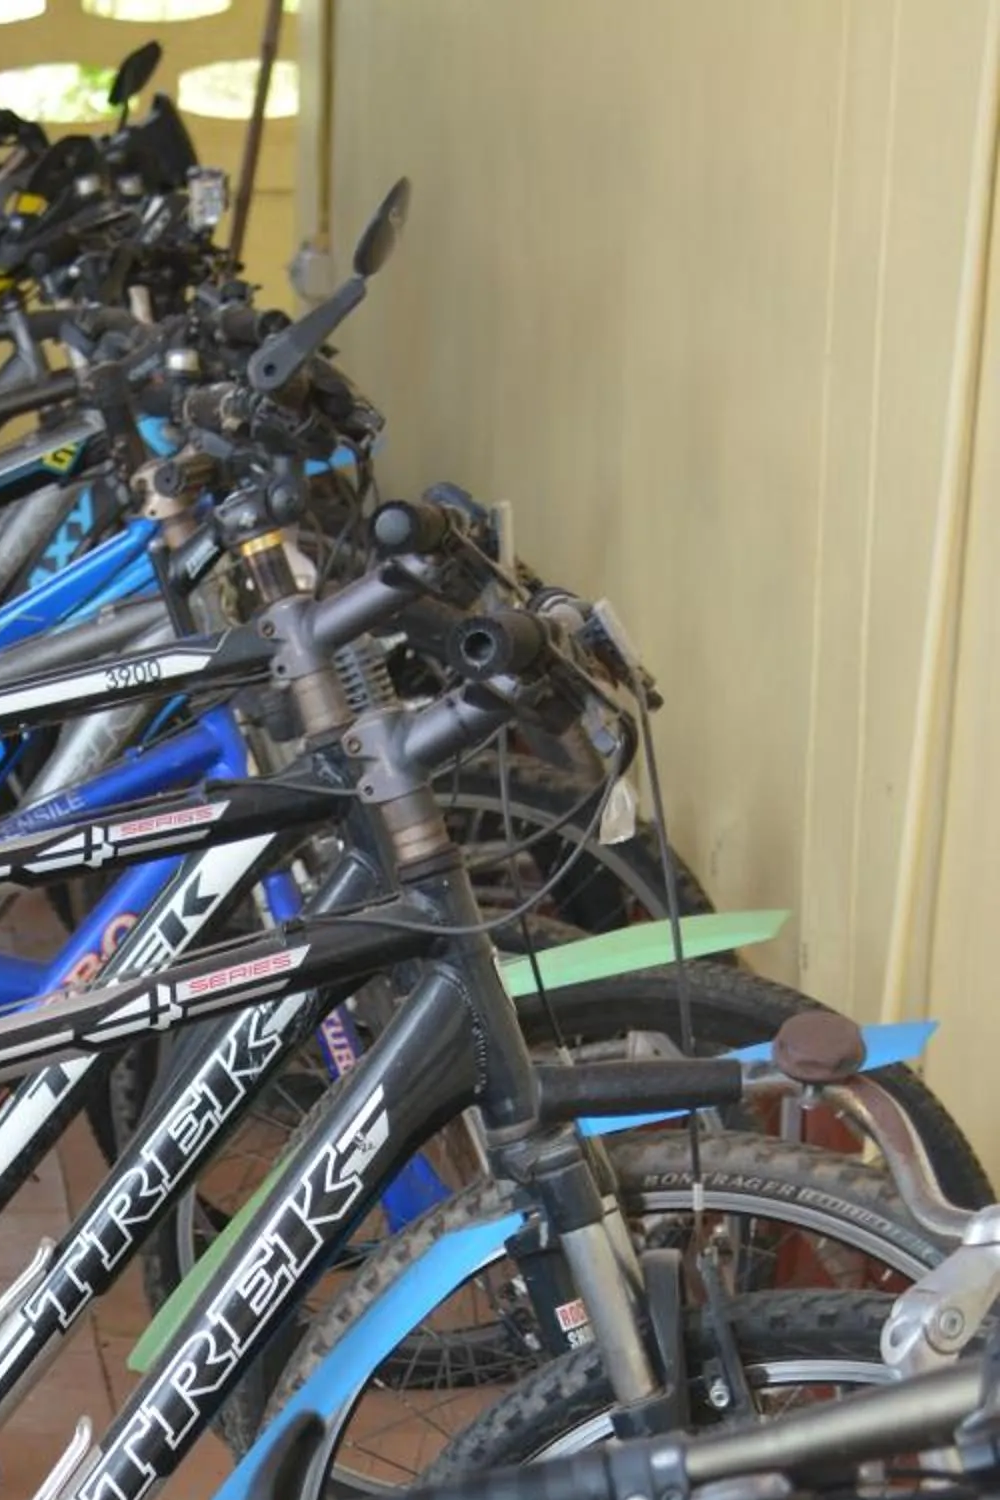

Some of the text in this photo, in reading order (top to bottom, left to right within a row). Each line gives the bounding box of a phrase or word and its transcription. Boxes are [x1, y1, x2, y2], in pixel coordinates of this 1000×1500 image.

[104, 659, 161, 691] 3900
[119, 804, 215, 837] SERIES
[28, 869, 220, 1100] TEK
[188, 954, 292, 994] SERIES
[22, 1001, 284, 1330] TREK
